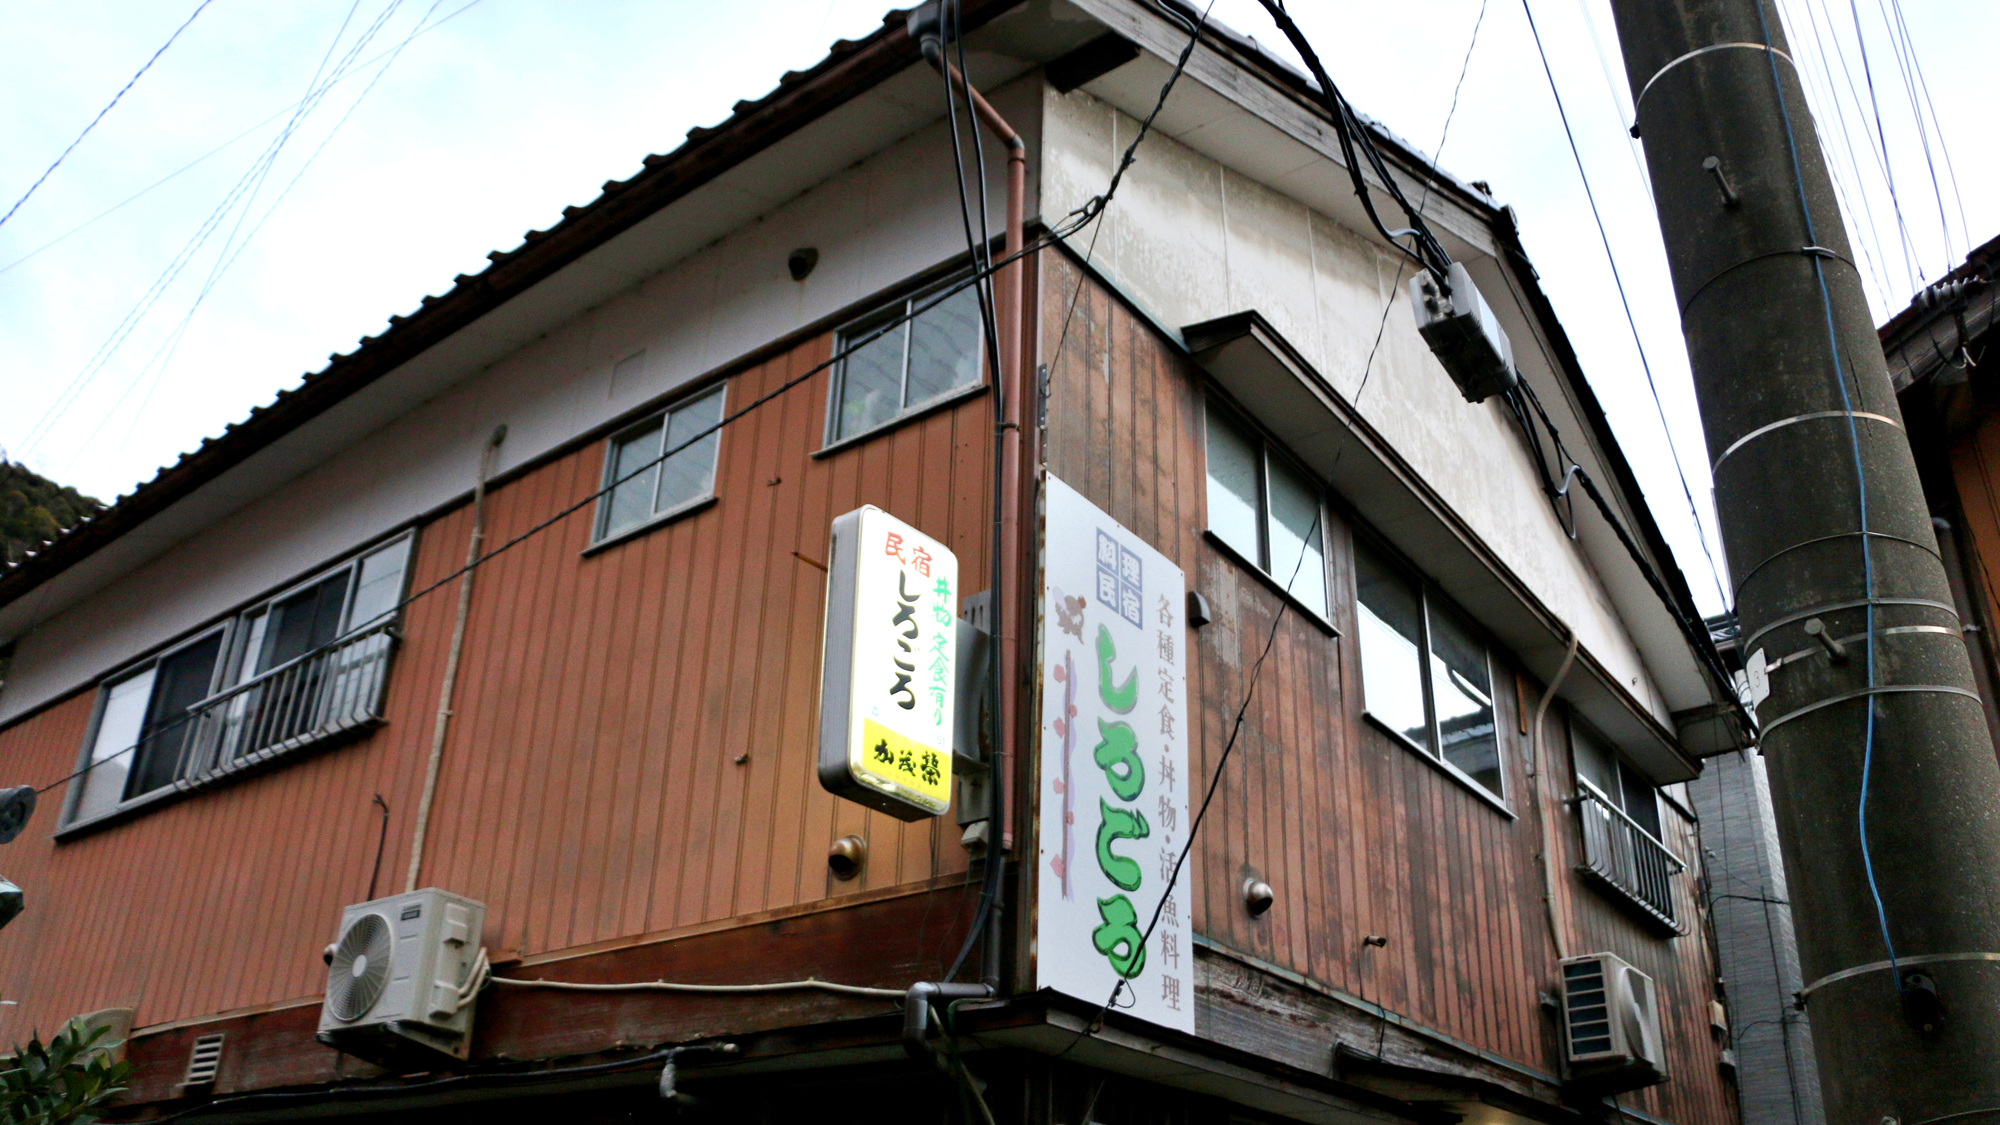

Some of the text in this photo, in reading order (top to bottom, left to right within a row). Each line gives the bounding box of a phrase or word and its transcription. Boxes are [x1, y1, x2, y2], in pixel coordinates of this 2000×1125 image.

[885, 531, 932, 578] 民宿
[1098, 570, 1141, 624] 民宿
[889, 569, 921, 711] しろごろ
